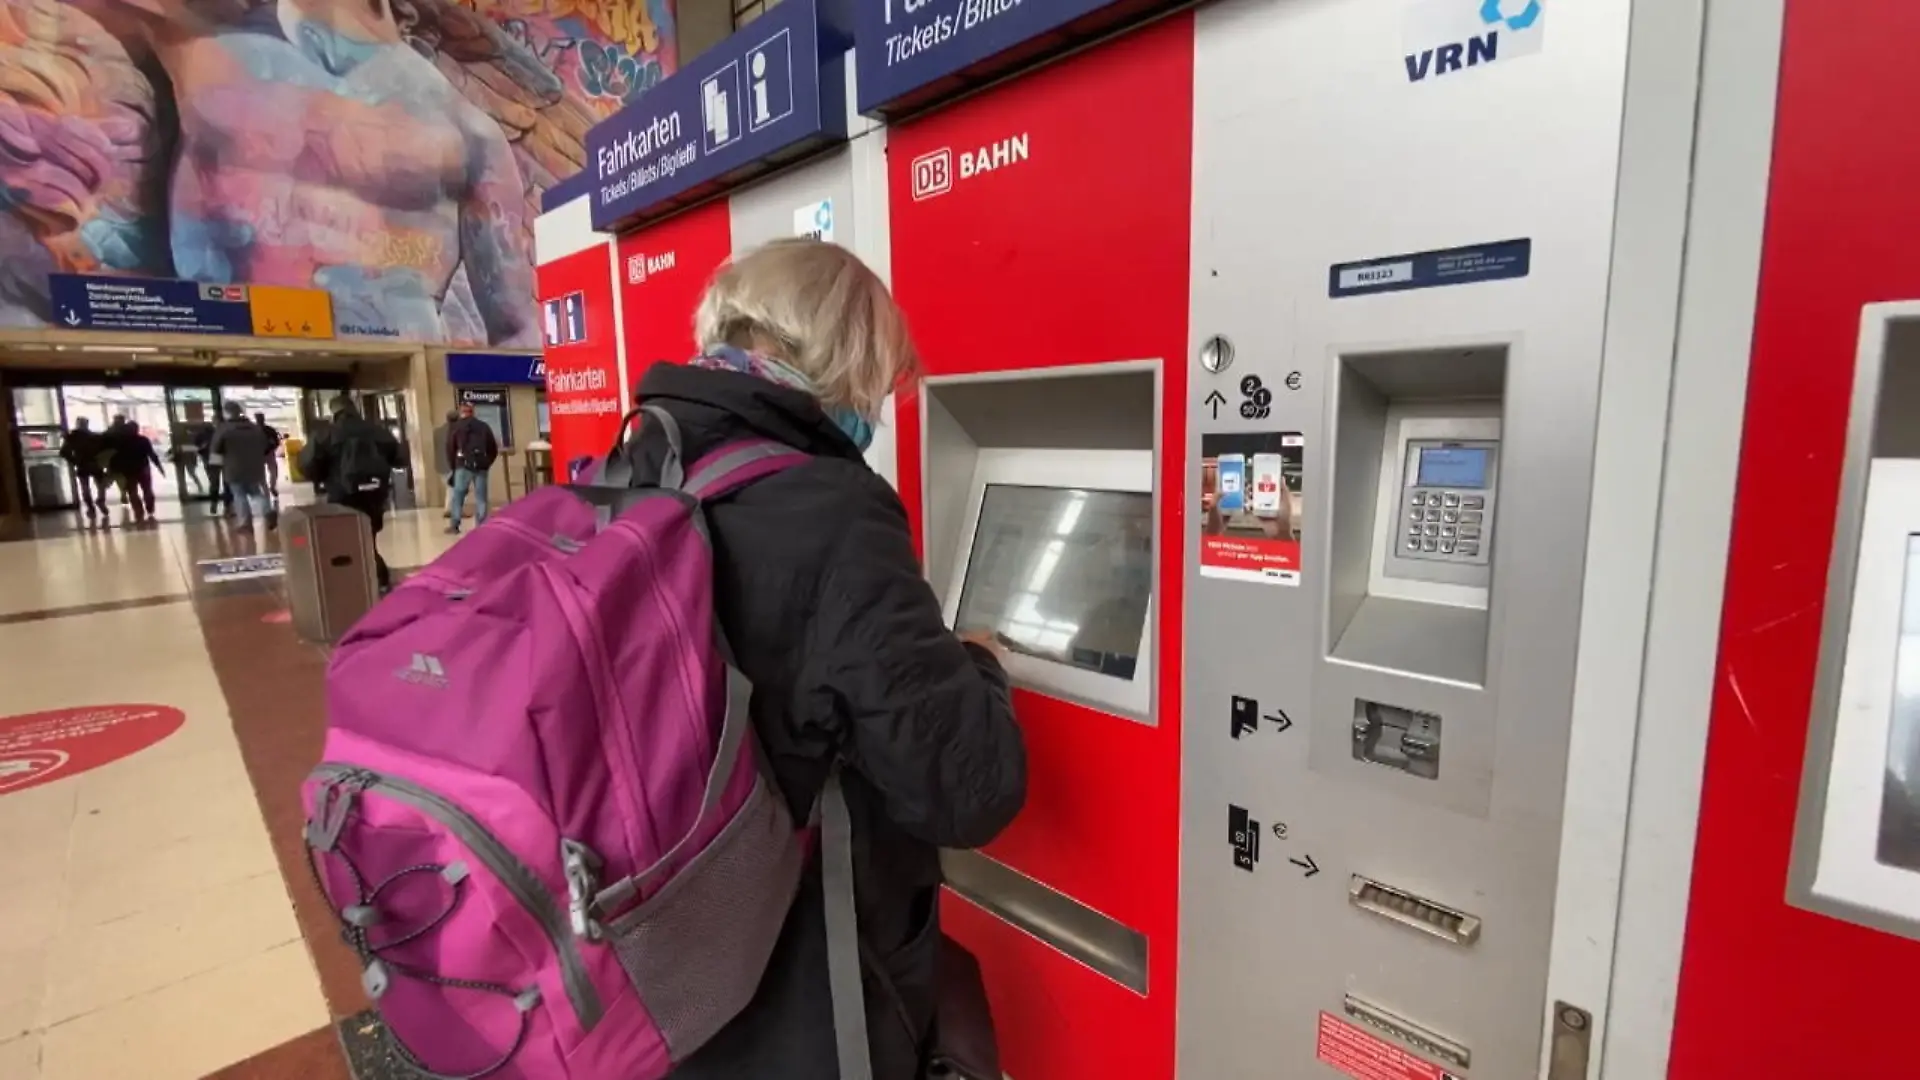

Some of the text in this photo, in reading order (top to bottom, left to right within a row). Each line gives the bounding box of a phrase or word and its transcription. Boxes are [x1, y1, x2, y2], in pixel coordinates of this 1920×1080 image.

[1405, 31, 1498, 82] VRN
[598, 111, 681, 180] Fahrkarten
[917, 132, 1029, 191] DB BAHN
[647, 251, 676, 275] BAHN
[463, 390, 500, 403] Change
[548, 368, 606, 393] Fahrkarten
